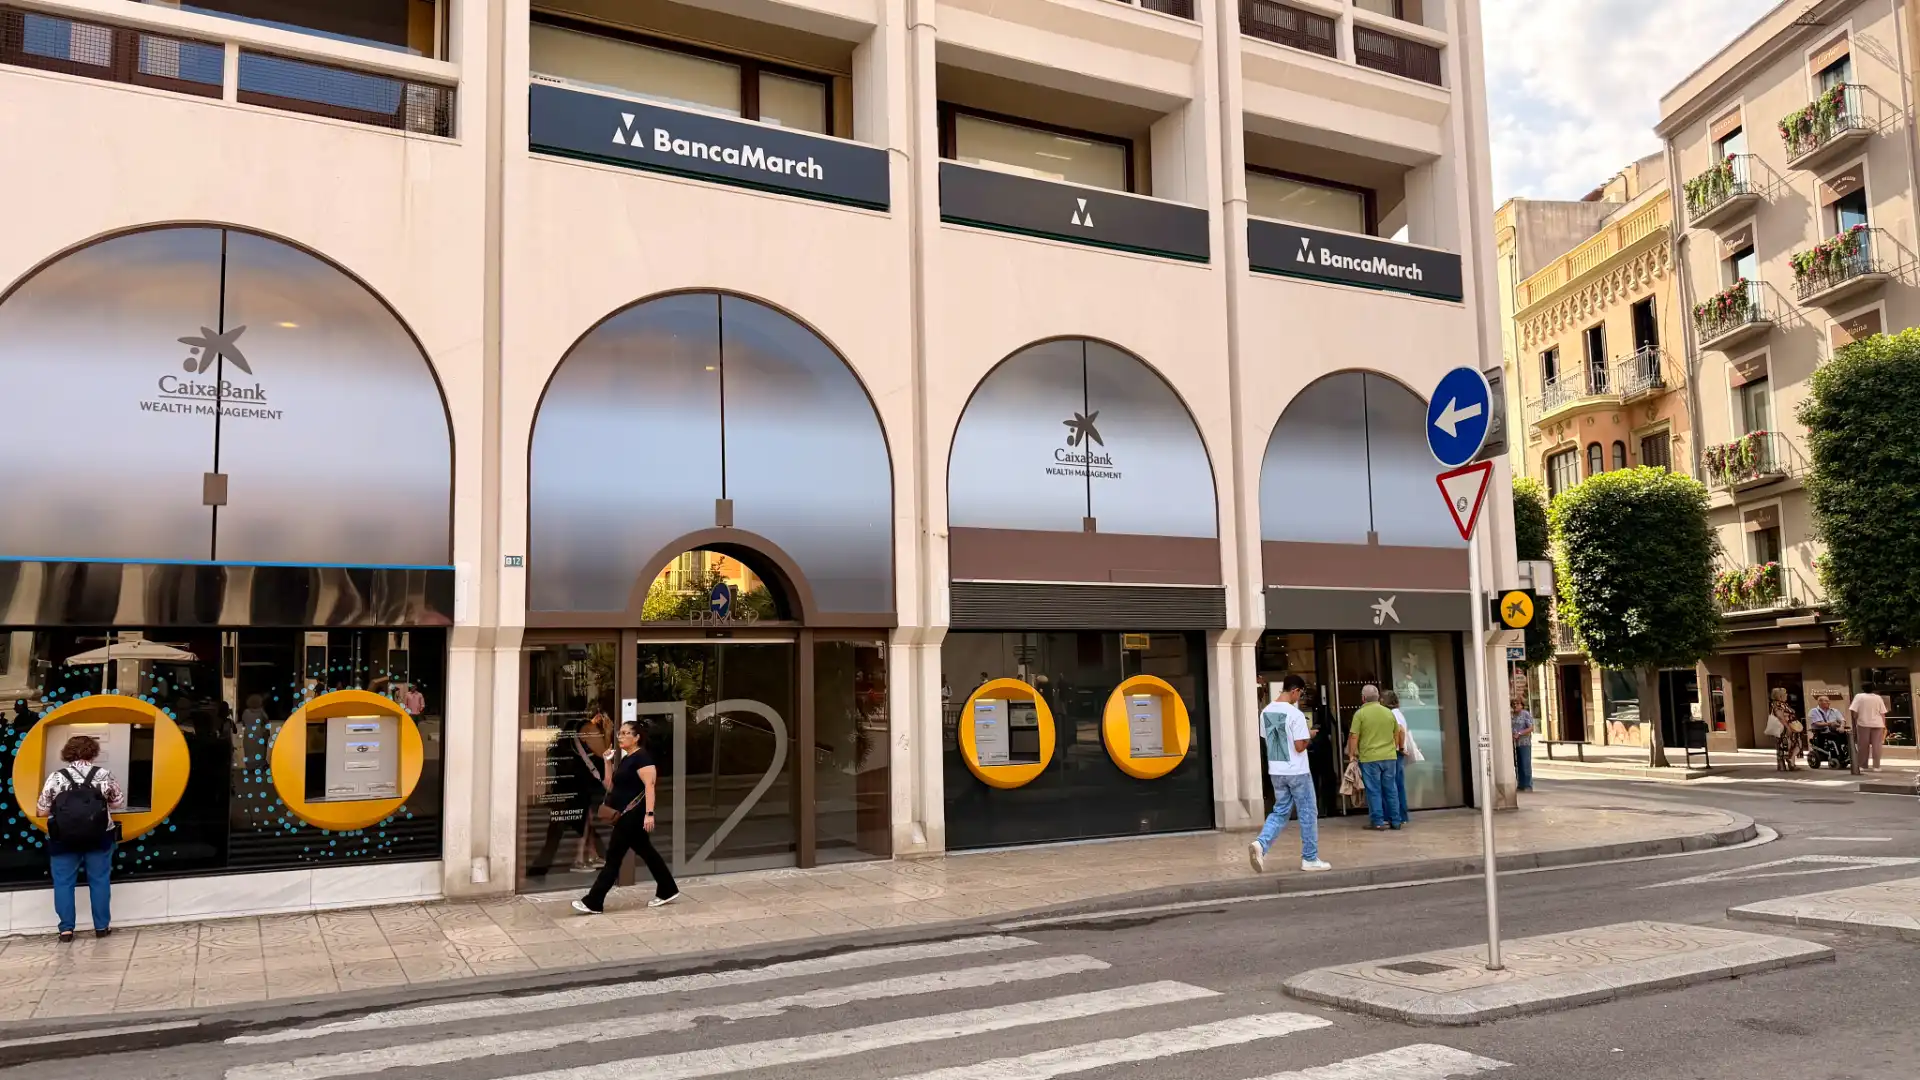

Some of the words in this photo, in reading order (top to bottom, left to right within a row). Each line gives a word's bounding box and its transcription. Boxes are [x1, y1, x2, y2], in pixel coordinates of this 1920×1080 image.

[653, 127, 824, 180] BancaMarch
[1320, 247, 1423, 281] BancaMarch
[158, 374, 267, 401] CaixaBank
[140, 401, 192, 415] WEALTH
[195, 404, 284, 420] MANAGEMENT
[1054, 447, 1113, 466] CaixaBank
[1045, 467, 1073, 476] WEALTH
[637, 699, 797, 877] 12
